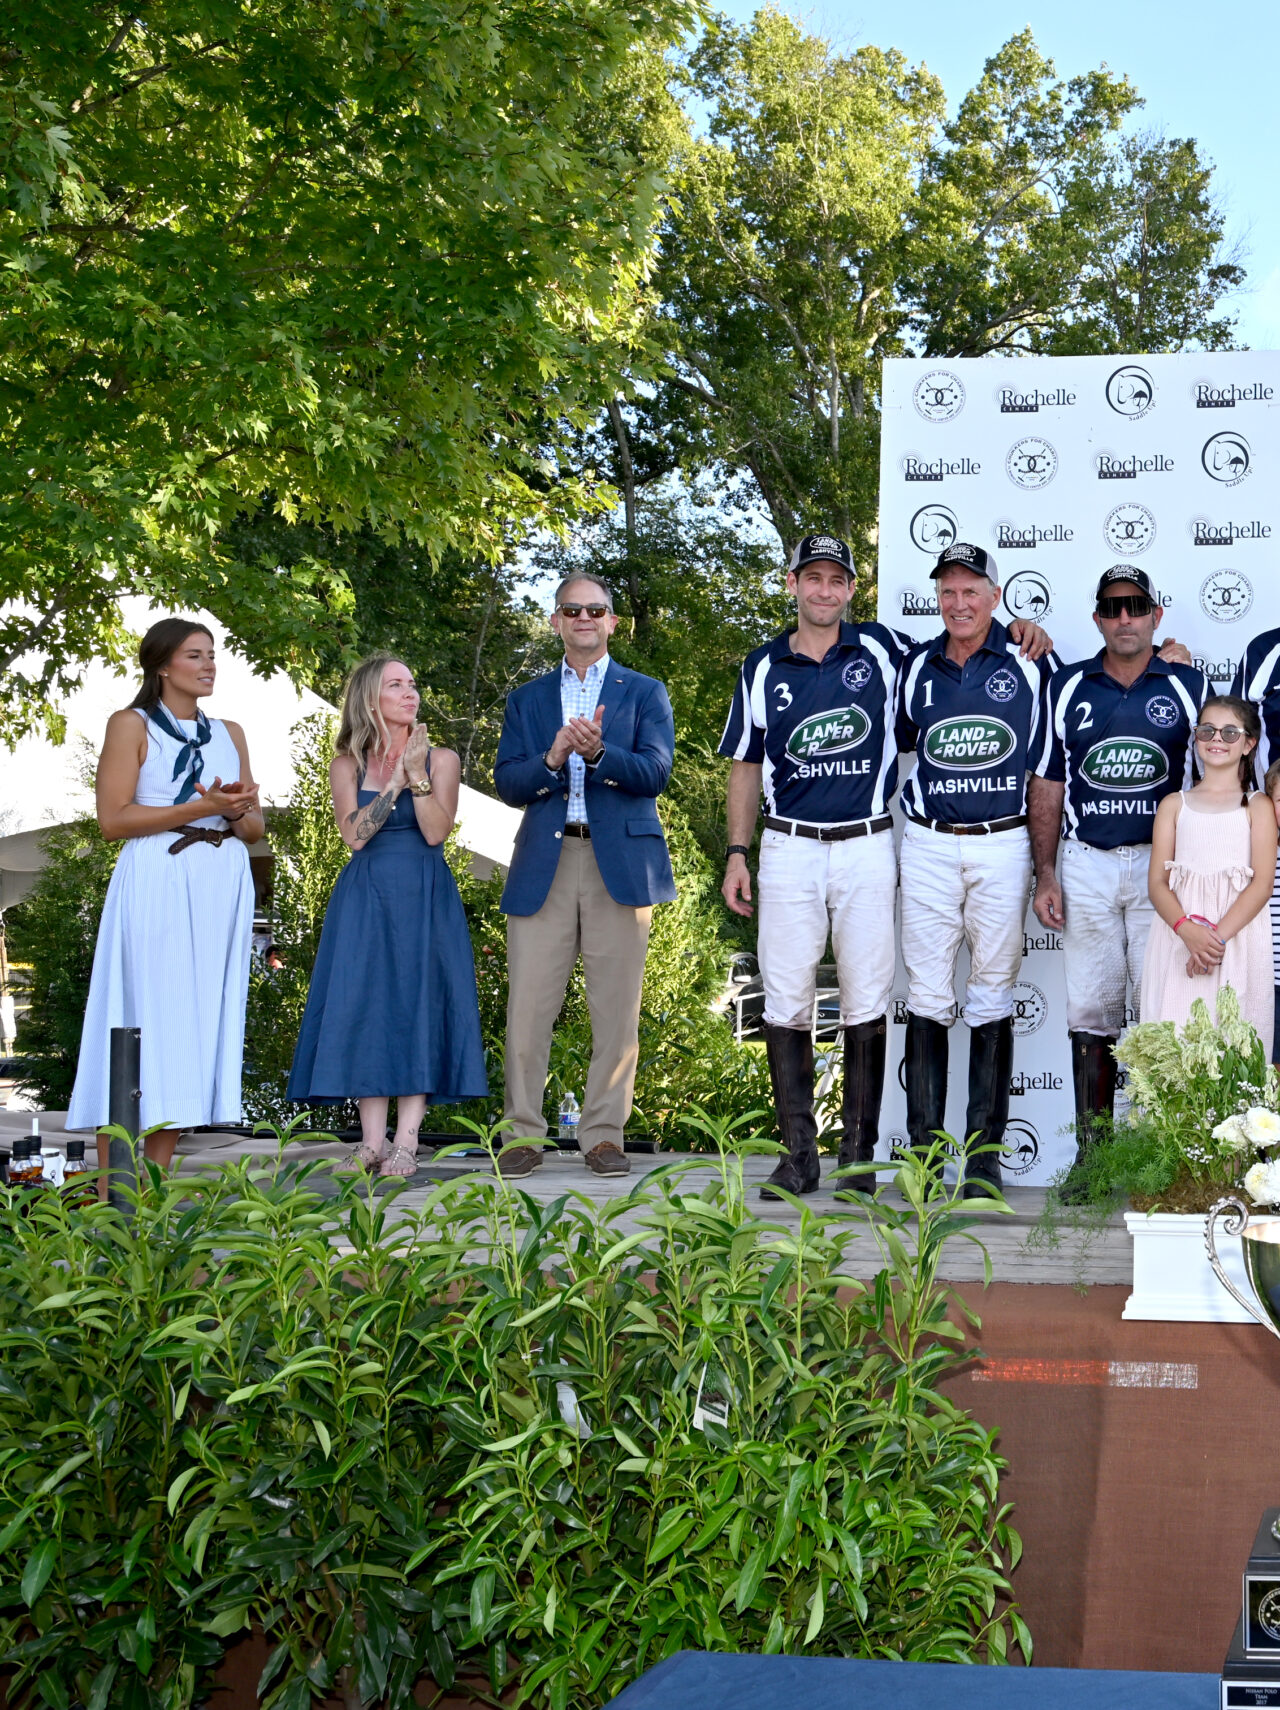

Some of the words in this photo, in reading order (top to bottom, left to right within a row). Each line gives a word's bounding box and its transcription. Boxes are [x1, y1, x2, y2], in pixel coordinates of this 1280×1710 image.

[1002, 389, 1076, 405] Rochelle
[1198, 384, 1273, 400] Rochelle
[1129, 411, 1148, 421] Saddle
[906, 458, 980, 474] Rochelle
[1100, 455, 1174, 472] Rochelle
[1225, 477, 1245, 489] Saddle
[999, 525, 1073, 541] Rochelle
[1195, 521, 1271, 538] Rochelle
[811, 548, 842, 558] NASHVILLE
[1193, 658, 1237, 676] Roch
[773, 682, 793, 711] 3
[922, 679, 935, 708] 1
[1075, 701, 1094, 731] 2
[939, 727, 985, 743] LAND
[943, 741, 1000, 758] ROVER
[1095, 749, 1143, 764] LAND
[788, 760, 871, 781] ASHVILLE
[1099, 764, 1156, 779] ROVER
[928, 776, 1017, 796] NASHVILLE
[1022, 933, 1063, 950] helle
[1032, 987, 1046, 1009] CHARITY
[1010, 1072, 1063, 1089] chelle
[1013, 1166, 1034, 1176] Saddle
